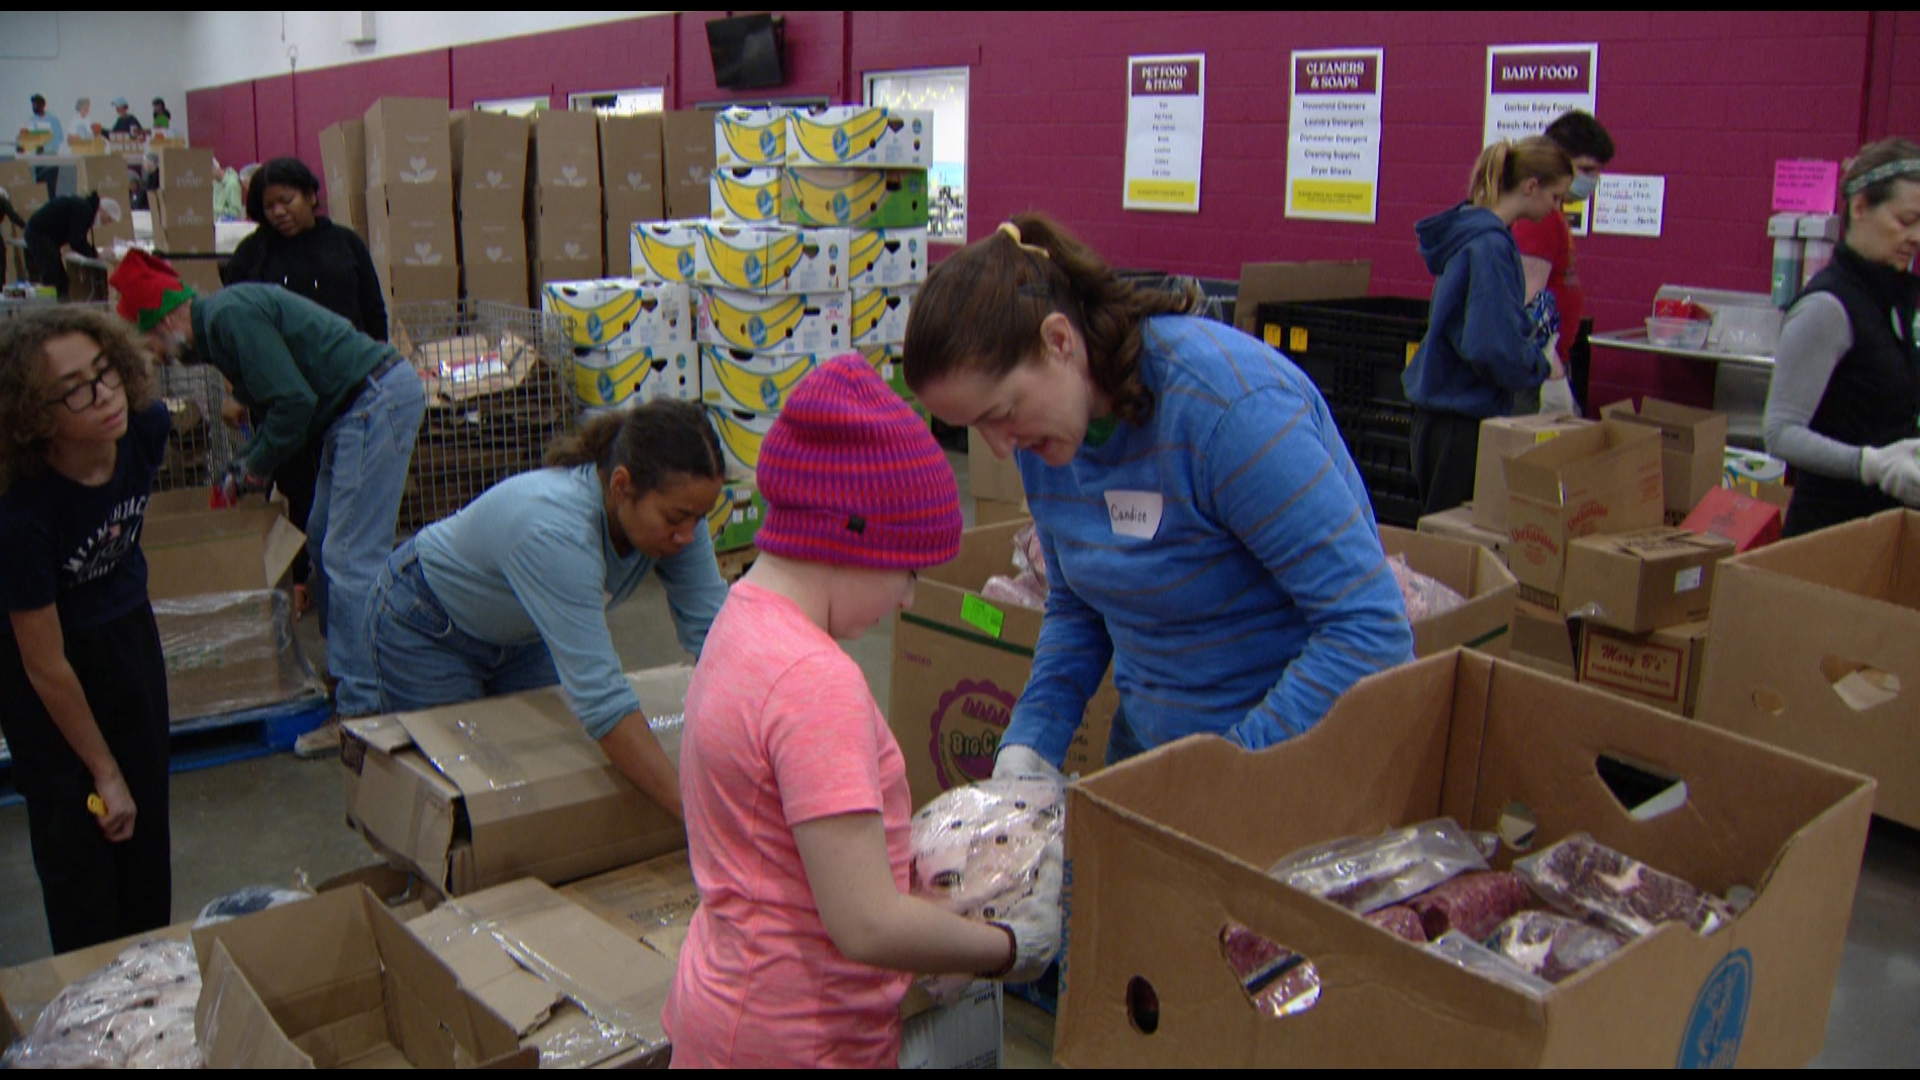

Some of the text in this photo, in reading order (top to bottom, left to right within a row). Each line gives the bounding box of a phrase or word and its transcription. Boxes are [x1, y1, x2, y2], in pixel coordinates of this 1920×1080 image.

[1142, 64, 1187, 79] PET FOOD
[1306, 61, 1364, 75] CLEANERS
[1502, 65, 1578, 79] BABY FOOD
[1145, 78, 1183, 91] & ITEMS
[1311, 75, 1358, 89] & SOAPS
[1302, 101, 1365, 110] Household Cleaners
[1504, 103, 1573, 114] Gerber Baby Food
[1304, 117, 1364, 129] Laundry Detergent
[1300, 132, 1368, 144] Dishwasher Detergent
[1304, 149, 1361, 161] Cleaning Supplies
[1311, 165, 1352, 176] Dryer Sheets
[1110, 502, 1147, 524] Candice
[1601, 644, 1635, 669] Mary
